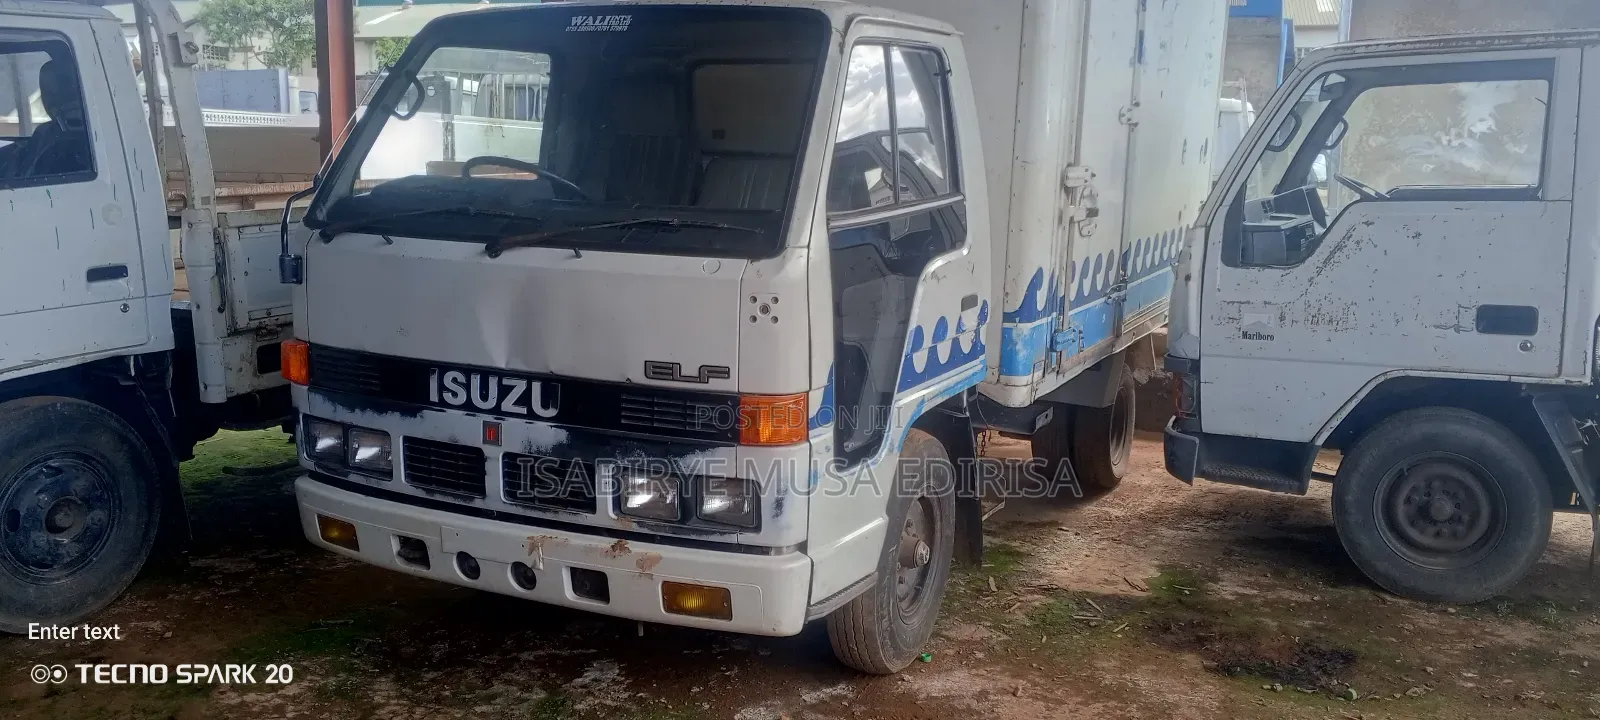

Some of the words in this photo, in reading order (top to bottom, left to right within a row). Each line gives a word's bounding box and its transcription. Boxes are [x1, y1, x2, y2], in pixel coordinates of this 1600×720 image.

[571, 15, 611, 26] WALI
[1241, 331, 1275, 341] Marlboro
[644, 360, 731, 384] ELF
[429, 367, 561, 418] ISUZU
